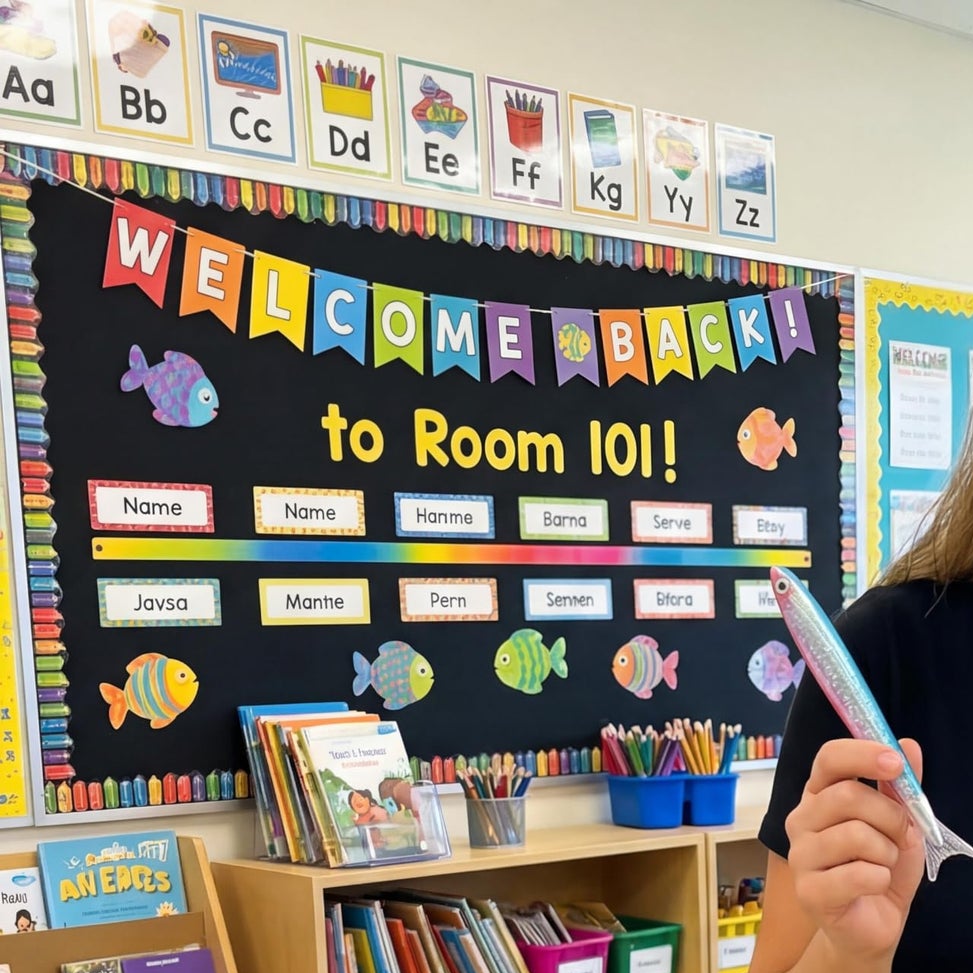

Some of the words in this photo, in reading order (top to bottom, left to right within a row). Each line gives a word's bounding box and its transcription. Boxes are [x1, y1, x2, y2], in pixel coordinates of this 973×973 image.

[2, 65, 55, 107] Aa
[119, 85, 167, 125] Bb
[229, 106, 273, 144] Cc
[328, 125, 371, 162] Dd
[423, 142, 460, 177] Ee
[511, 157, 541, 190] Ff
[590, 171, 622, 211] Kg
[663, 185, 693, 222] Yy
[734, 199, 760, 228] Zz
[116, 216, 522, 360] WELCOME
[609, 299, 799, 363] BACK!
[321, 403, 384, 463] to
[414, 408, 564, 474] Room
[123, 496, 182, 516] Name
[284, 502, 336, 520] Name
[543, 511, 587, 527] Barna
[653, 514, 691, 530] Serve
[133, 593, 188, 611] Javsa
